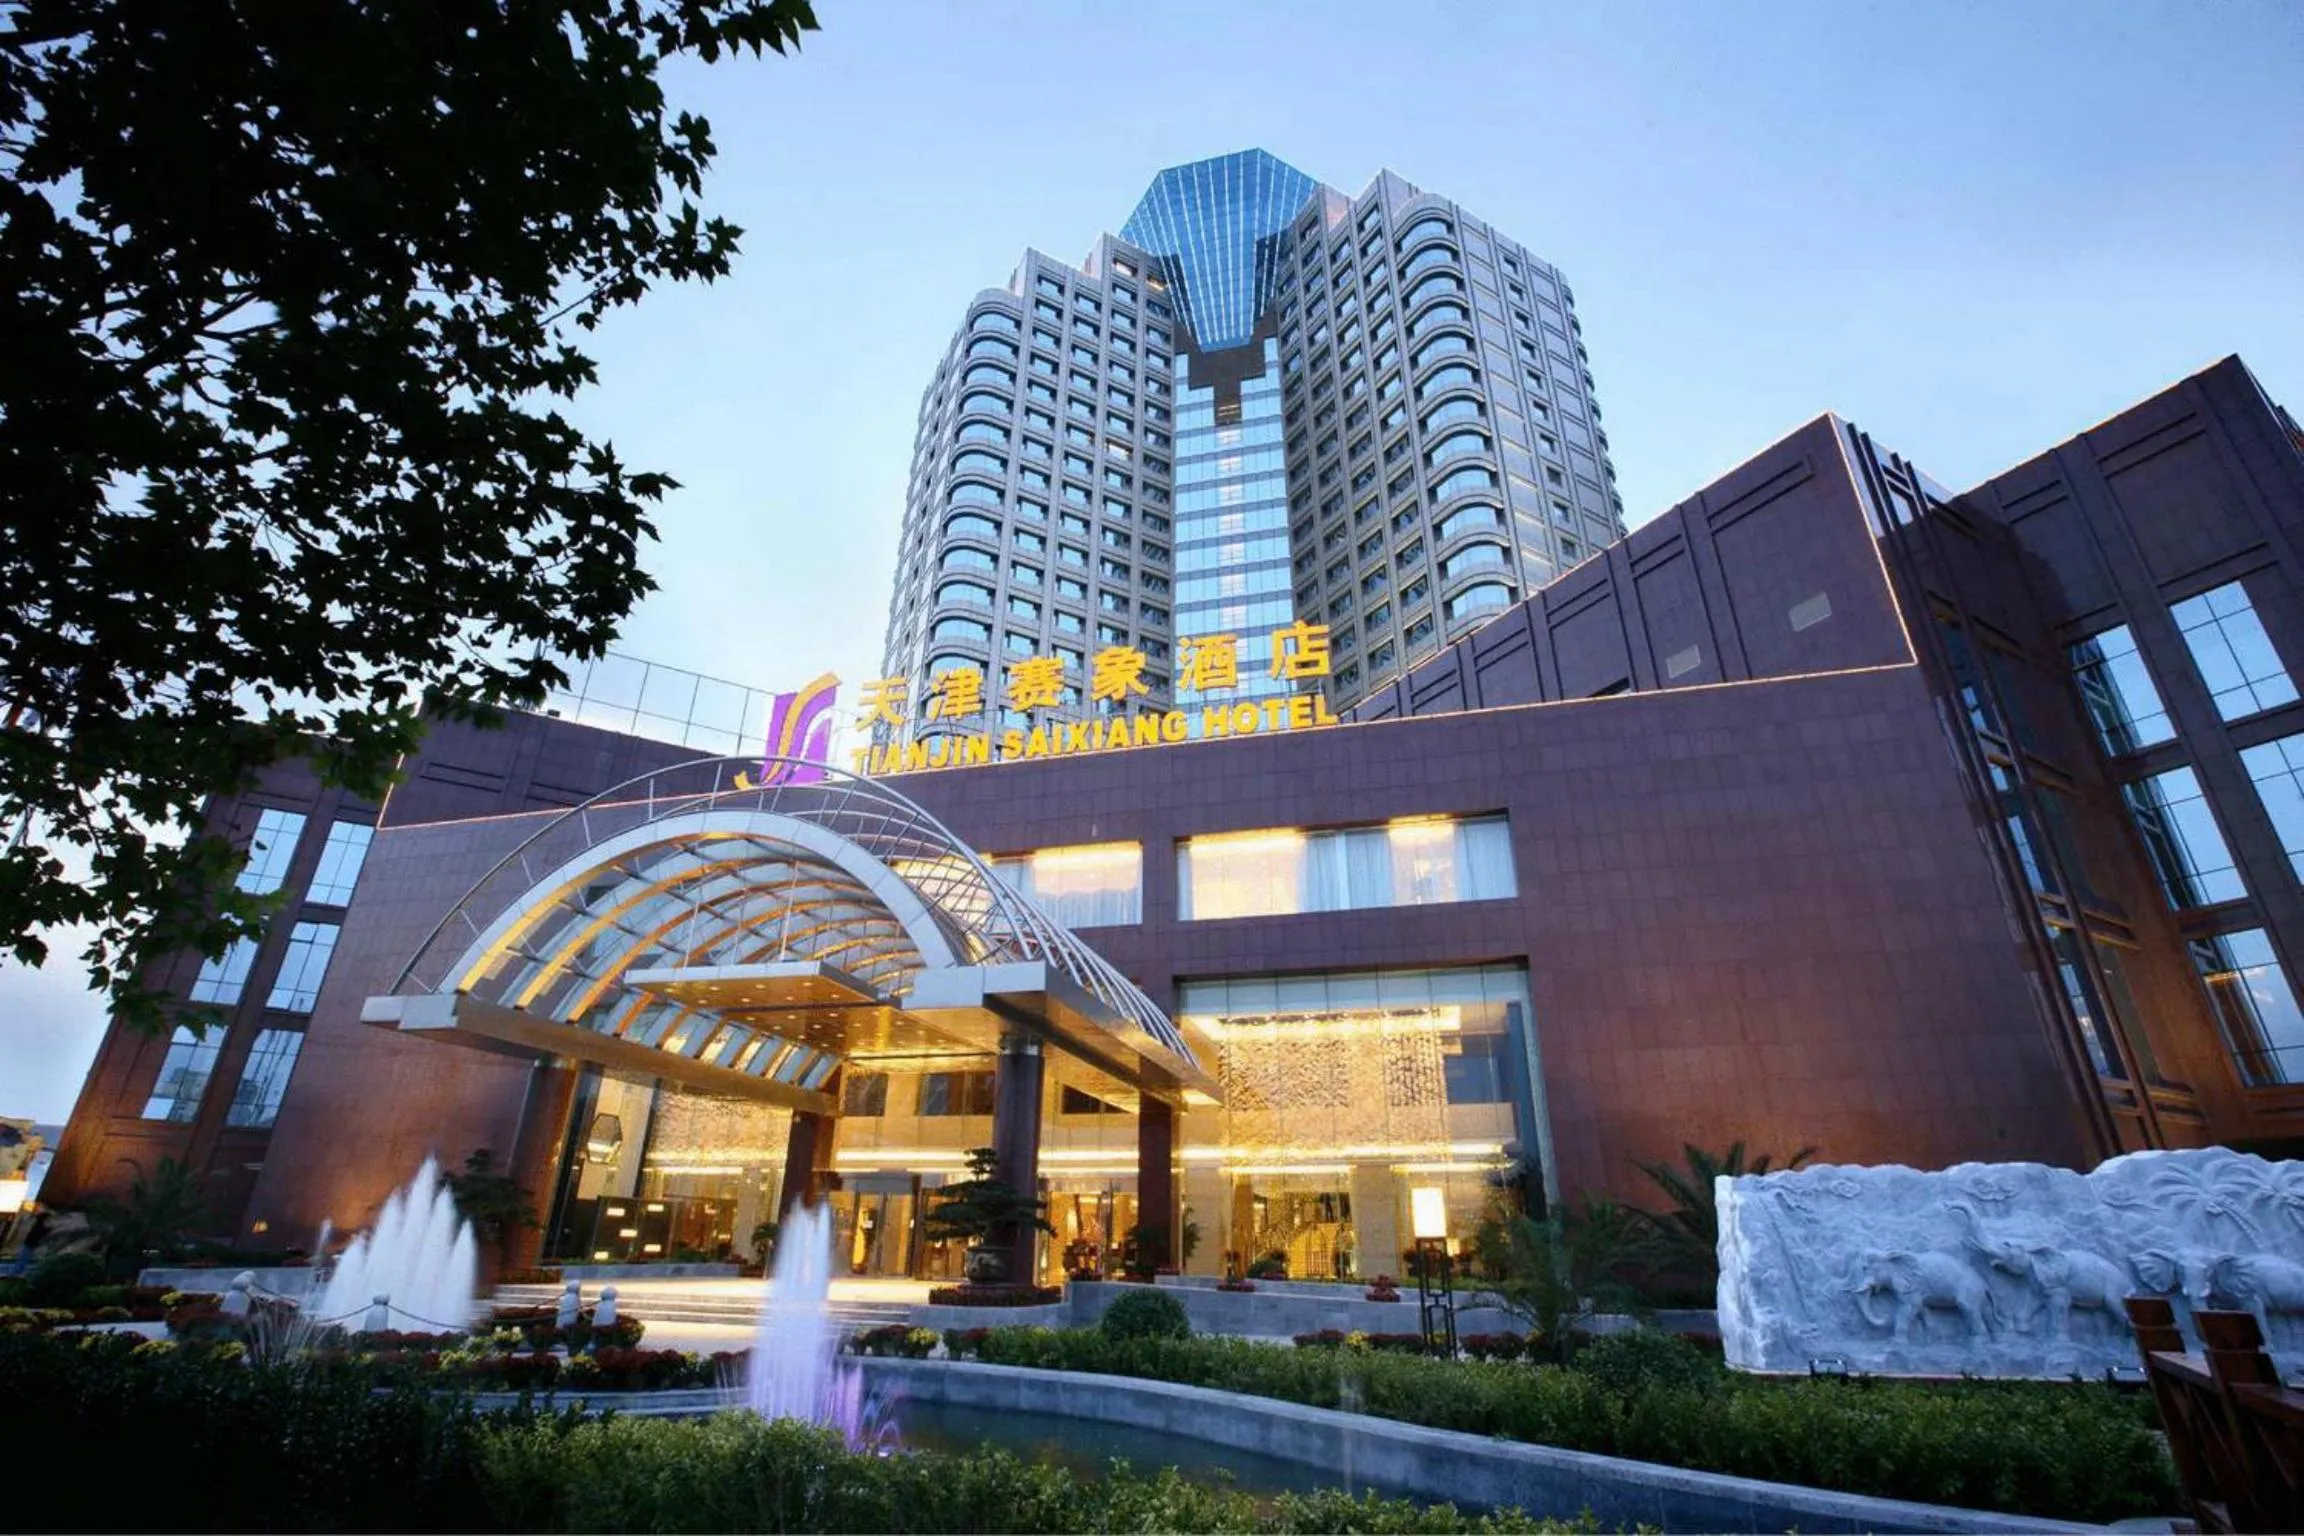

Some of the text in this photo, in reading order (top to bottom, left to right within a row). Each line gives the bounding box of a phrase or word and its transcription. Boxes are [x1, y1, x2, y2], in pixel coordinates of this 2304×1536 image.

[855, 619, 1330, 732] 天津赛象酒店
[850, 693, 1339, 776] TIANJIN SAIXIANG HOTEL
